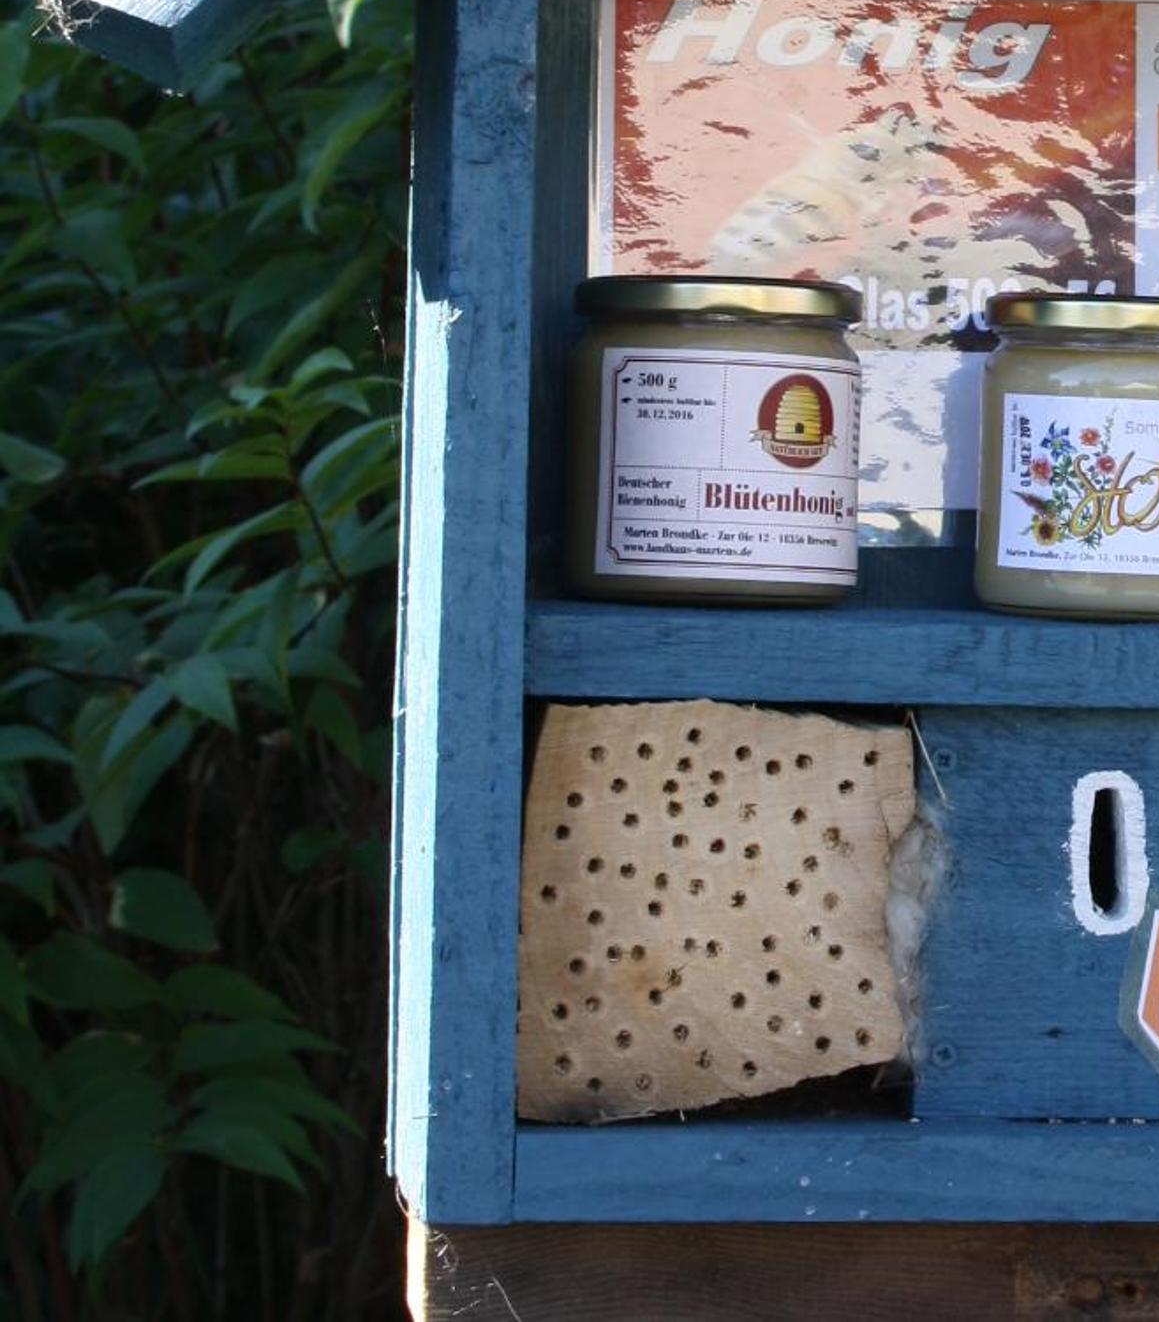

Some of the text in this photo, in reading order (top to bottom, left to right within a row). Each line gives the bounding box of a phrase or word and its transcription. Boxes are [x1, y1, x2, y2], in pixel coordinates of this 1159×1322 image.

[840, 276, 930, 331] las
[637, 372, 678, 391] 500 g
[618, 476, 672, 489] Deutscher
[617, 493, 687, 509] Bienenhonig
[704, 482, 844, 523] Blütenhonig
[759, 532, 770, 543] 12
